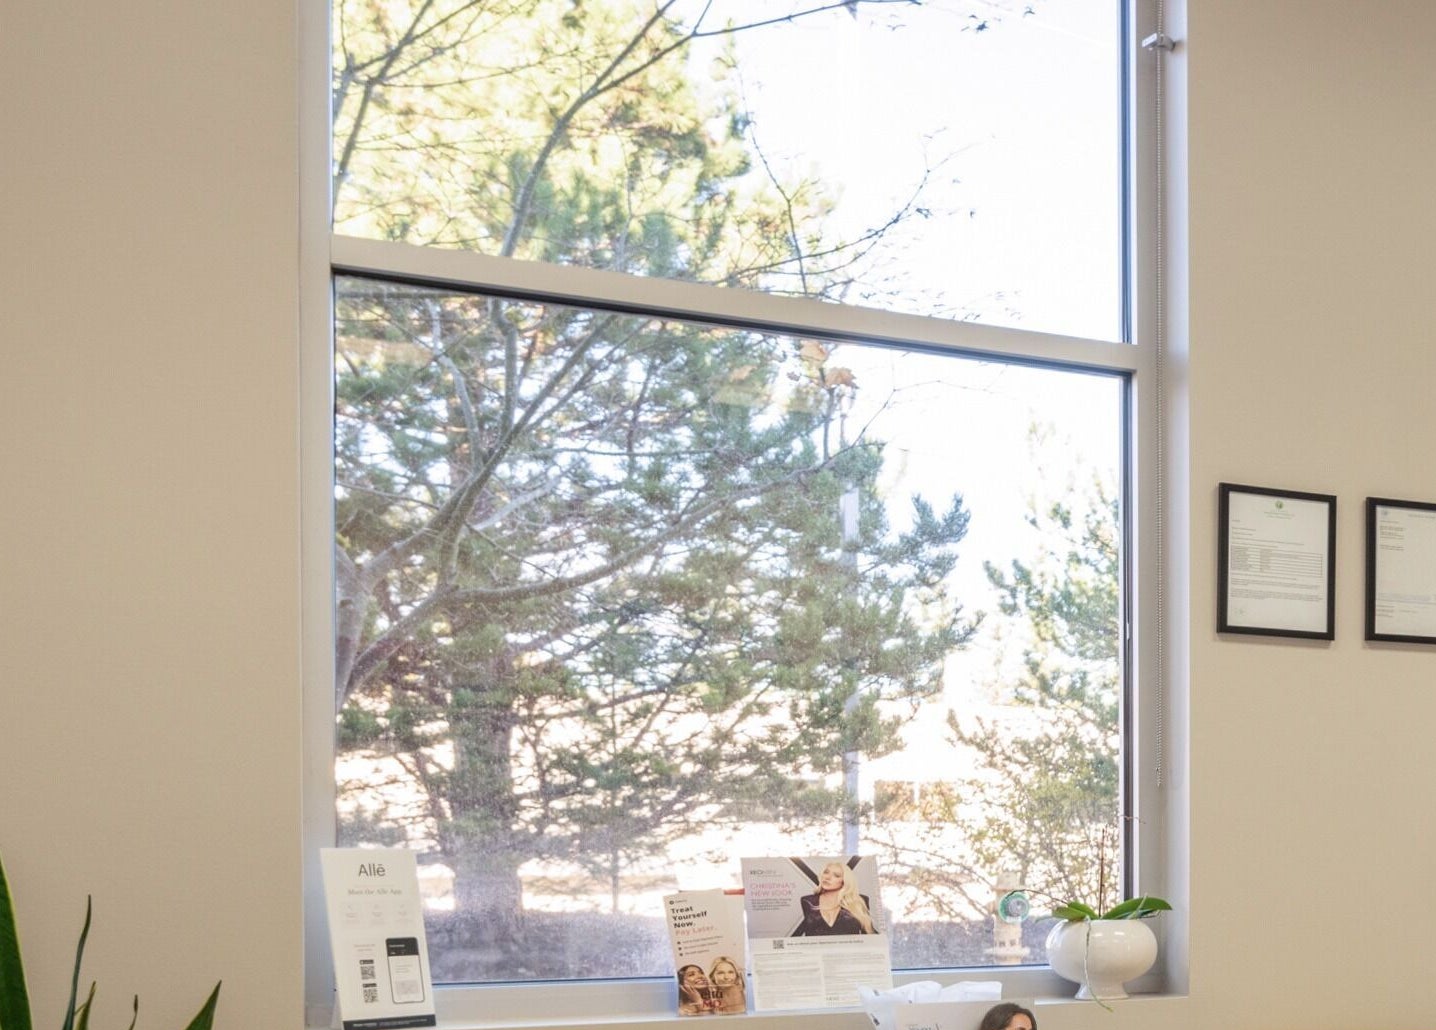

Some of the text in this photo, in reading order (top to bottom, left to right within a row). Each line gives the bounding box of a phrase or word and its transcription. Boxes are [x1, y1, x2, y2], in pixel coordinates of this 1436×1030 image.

[671, 906, 693, 914] Treat
[672, 911, 707, 921] Yourself
[675, 928, 690, 937] Pay
